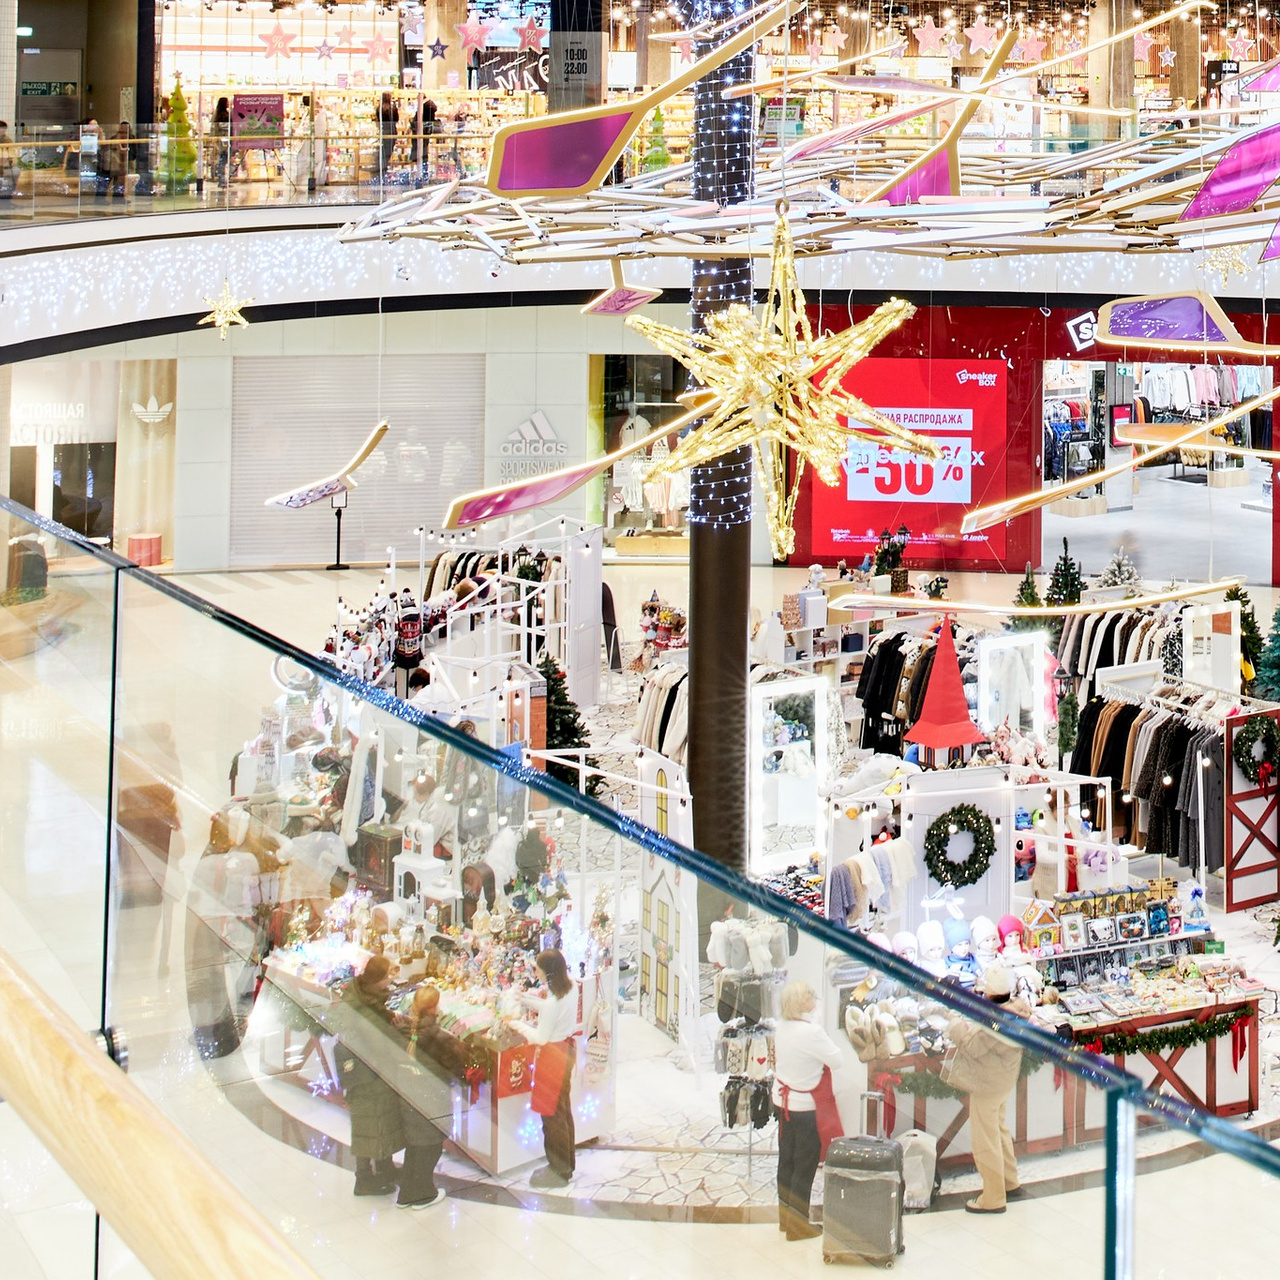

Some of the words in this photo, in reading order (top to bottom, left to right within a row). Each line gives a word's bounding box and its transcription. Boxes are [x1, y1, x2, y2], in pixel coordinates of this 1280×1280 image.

[564, 48, 588, 62] 10:00
[564, 62, 588, 75] 22:00
[978, 378, 997, 387] BOX
[903, 413, 963, 425] РАСПРОДАЖА
[500, 439, 568, 455] adidas
[500, 460, 567, 476] SPORTSWEAR
